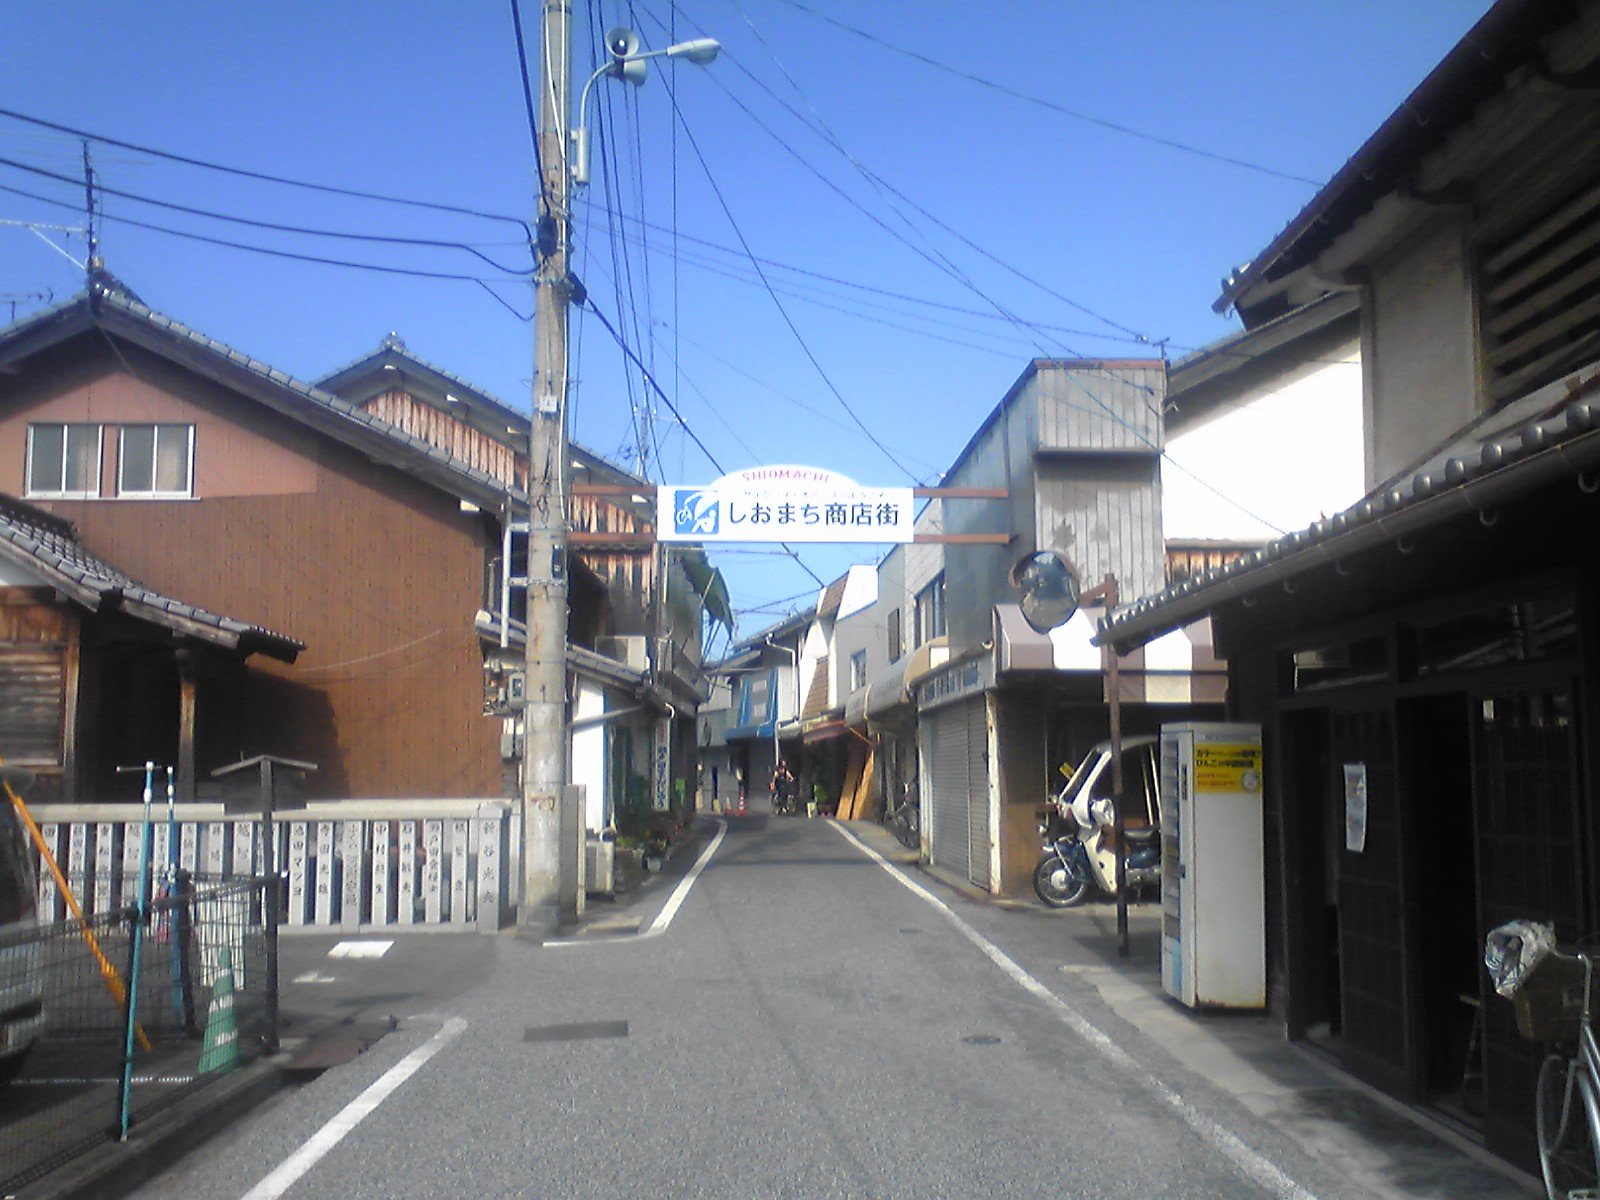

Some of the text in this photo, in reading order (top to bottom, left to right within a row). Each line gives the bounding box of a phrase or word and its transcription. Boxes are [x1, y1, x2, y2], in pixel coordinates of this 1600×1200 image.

[742, 470, 830, 482] SHIOMACHI
[729, 502, 899, 527] しおまち商店街
